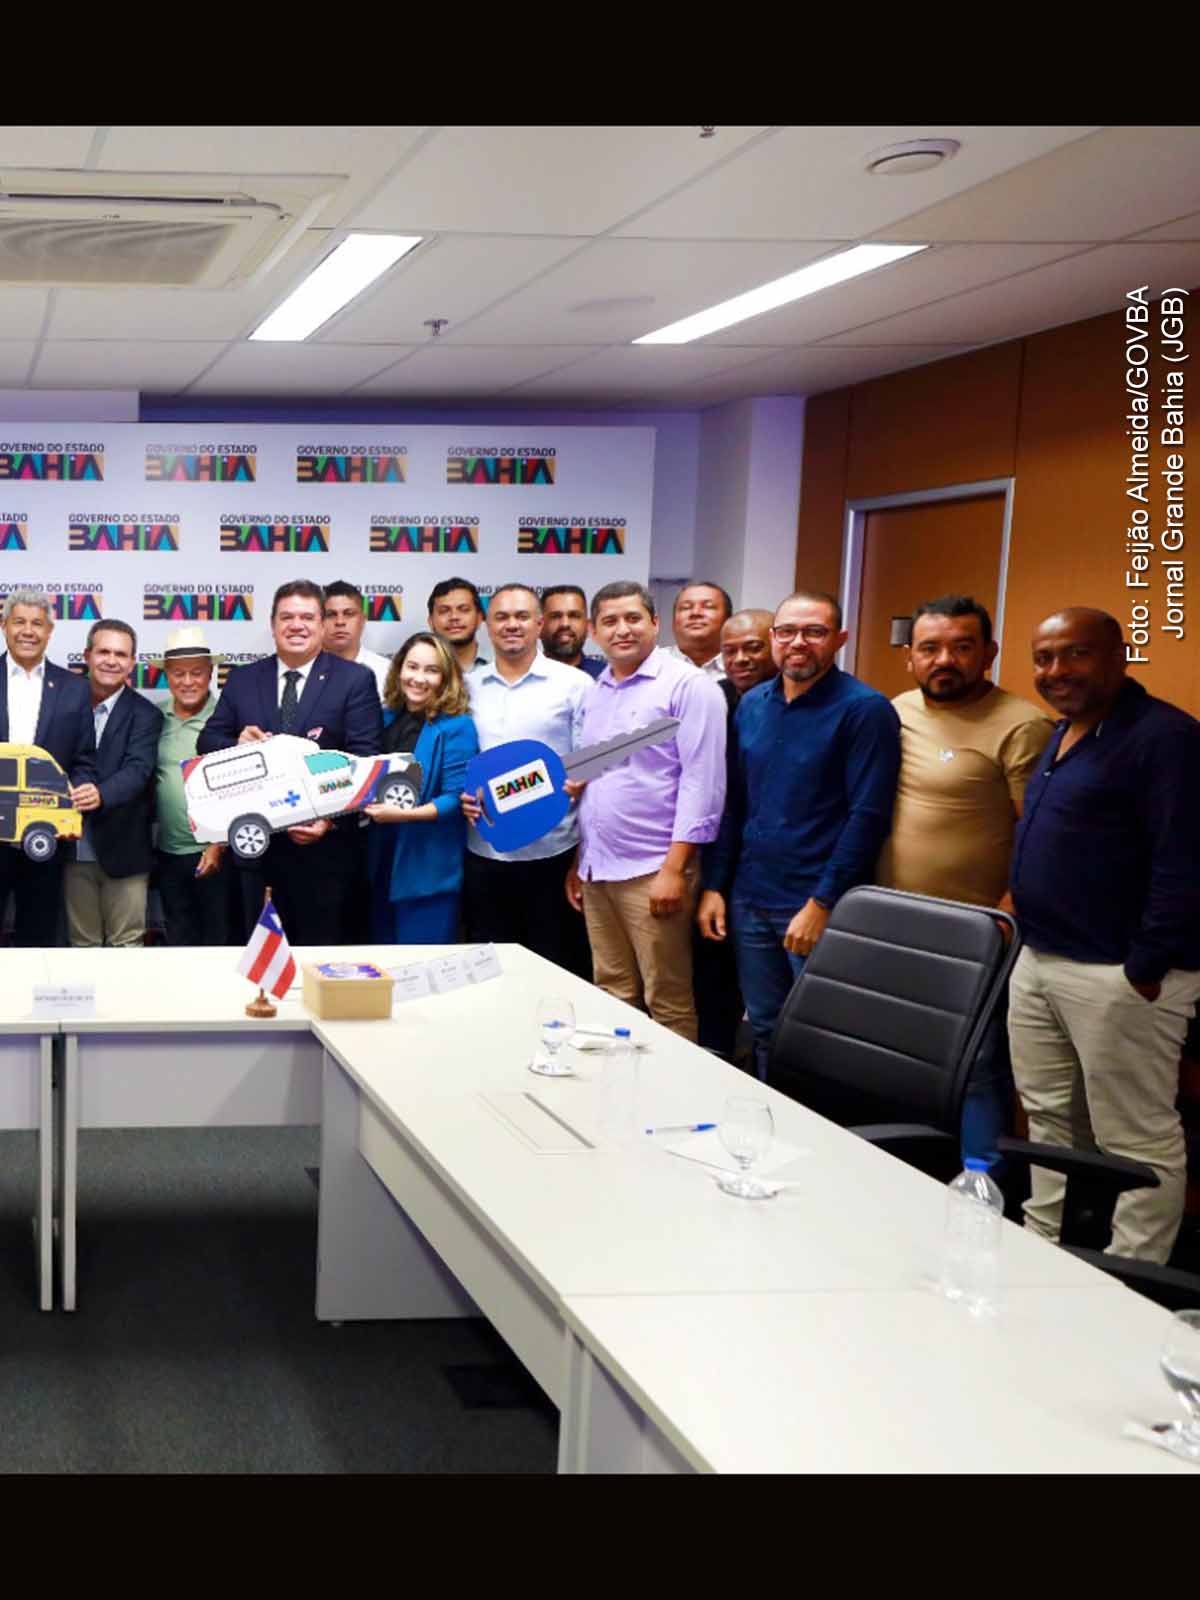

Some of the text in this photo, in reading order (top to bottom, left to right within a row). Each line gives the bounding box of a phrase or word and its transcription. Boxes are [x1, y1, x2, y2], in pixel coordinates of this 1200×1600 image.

[47, 442, 61, 453] DO
[64, 442, 104, 453] ESTADO
[200, 444, 214, 454] DO
[217, 444, 257, 454] ESTADO
[296, 446, 408, 456] GOVERNO DO ESTADO
[448, 446, 556, 457] GOVERNO DO ESTADO
[146, 455, 256, 482] BAHIA
[297, 456, 406, 482] BAHIA
[447, 458, 554, 484] BAHIA
[68, 512, 180, 524] GOVERNO DO ESTADO
[220, 514, 330, 524] GOVERNO DO ESTADO
[370, 515, 480, 526] GOVERNO DO ESTADO
[518, 516, 627, 528] GOVERNO DO ESTADO
[69, 524, 178, 551] BAHIA
[220, 525, 329, 552] BAHIA
[370, 526, 478, 552] BAHIA
[518, 528, 624, 554] BAHIA
[46, 583, 61, 592] DO
[63, 583, 104, 592] ESTADO
[144, 584, 254, 594] GOVERNO DO ESTADO
[365, 584, 403, 594] ESTADO
[144, 594, 254, 620] BAHIA
[496, 769, 544, 800] BAHIA
